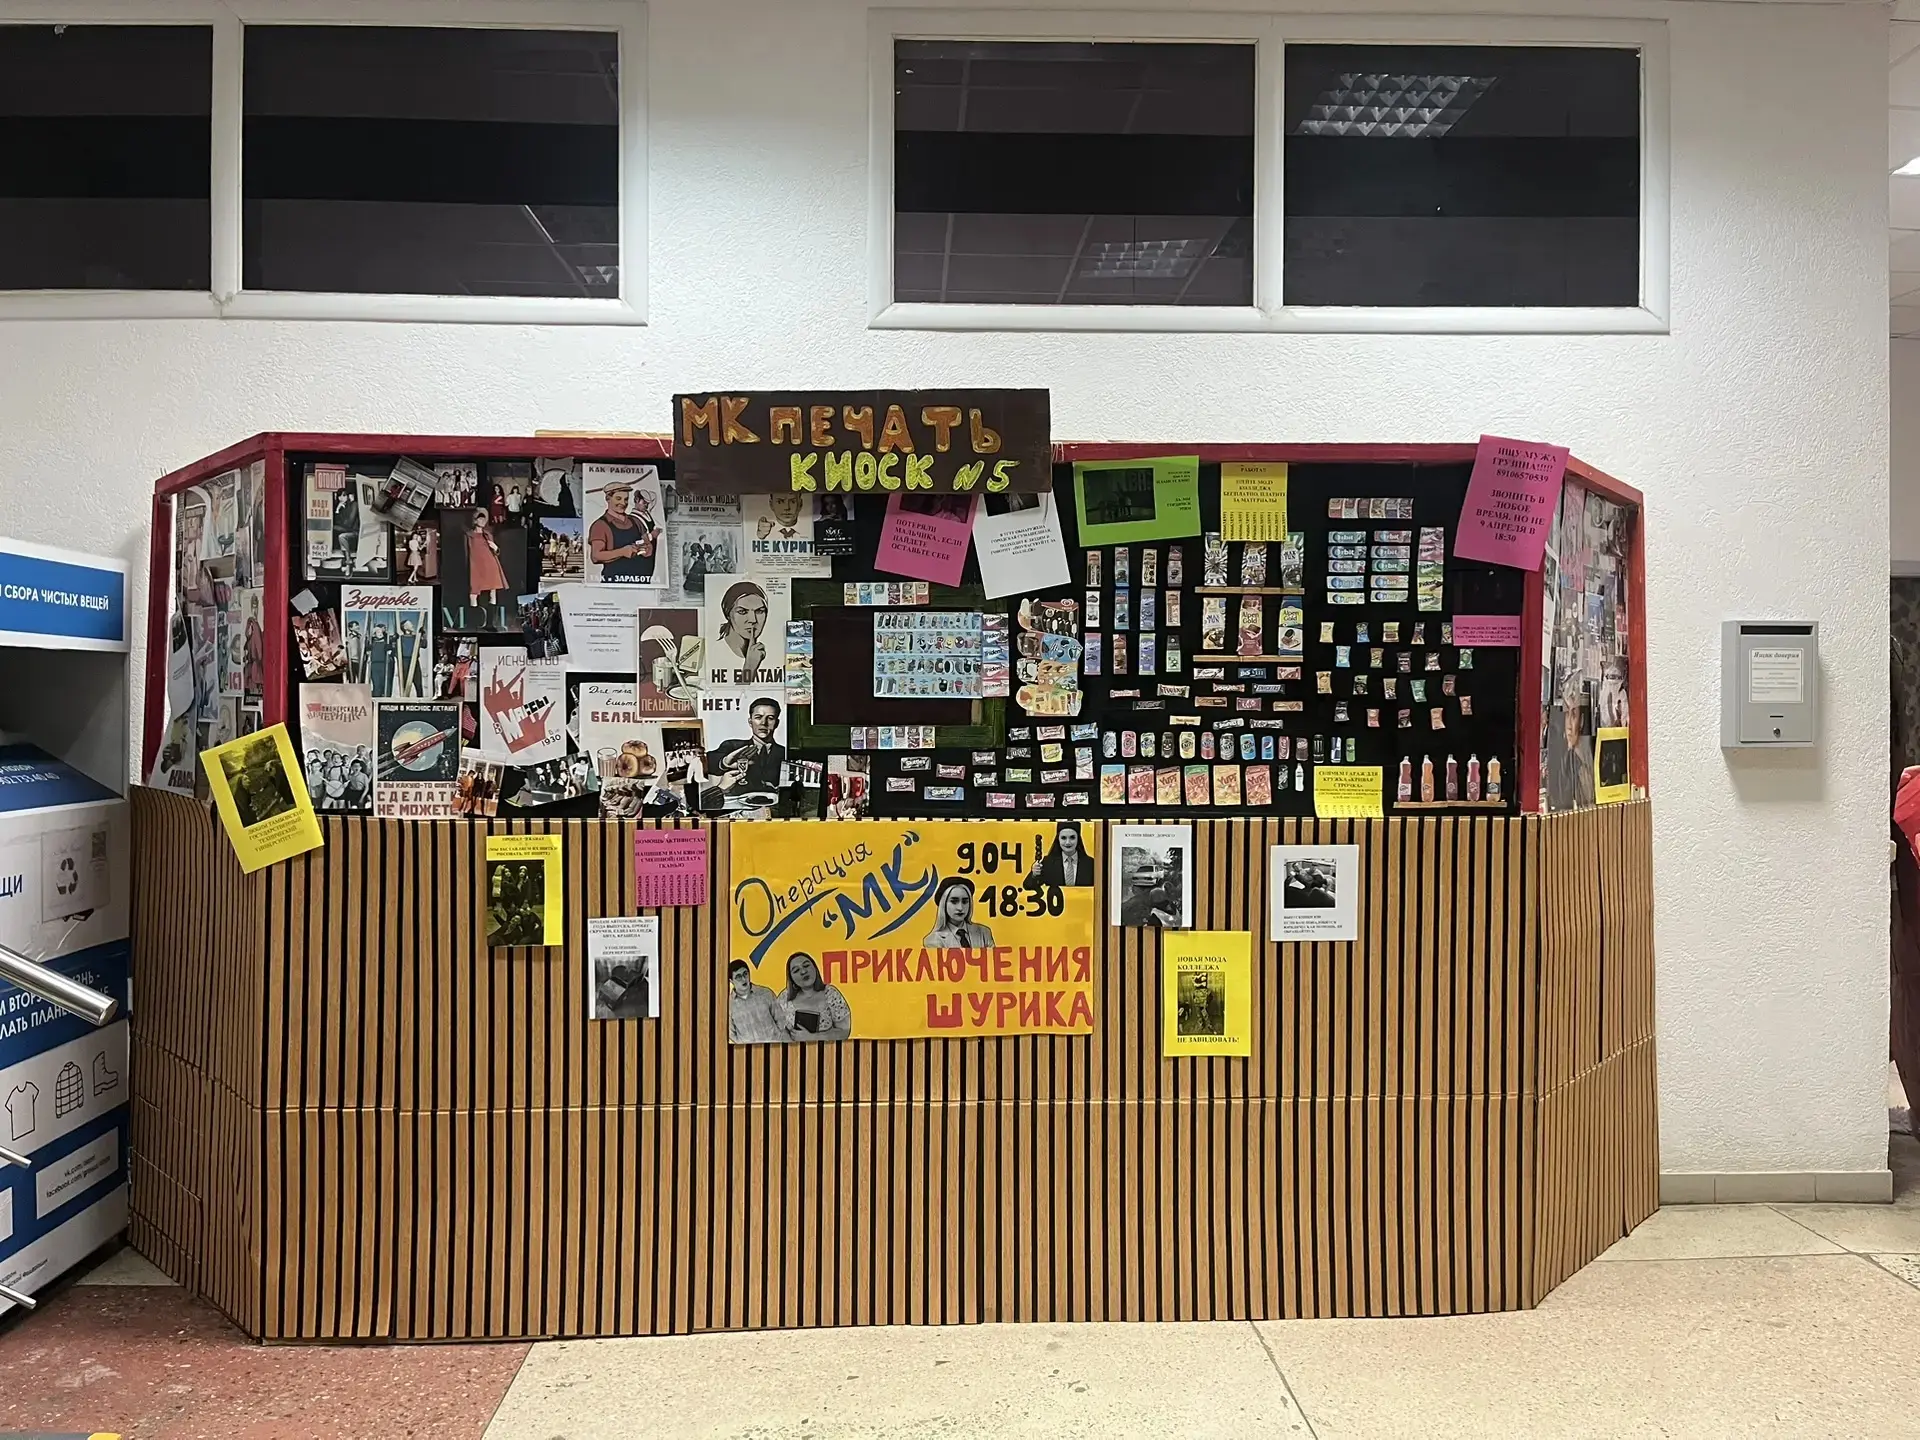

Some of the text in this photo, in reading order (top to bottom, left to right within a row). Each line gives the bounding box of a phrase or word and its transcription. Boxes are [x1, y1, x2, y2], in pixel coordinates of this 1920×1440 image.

[681, 396, 1002, 453] МК ПЕЧАТЬ
[1525, 450, 1557, 463] МУЖА
[790, 451, 935, 492] КИОСК
[1490, 489, 1545, 504] ЗВОНИТЬ В
[1493, 501, 1531, 513] ЛЮБОЕ
[896, 518, 937, 533] ПОТЕРЯЛИ
[1514, 514, 1528, 523] НО
[1531, 516, 1545, 525] НЕ
[1487, 521, 1526, 534] АПРЕЛЯ
[1529, 527, 1536, 535] В
[752, 540, 769, 552] НЕ
[893, 534, 928, 548] НАЙДЕТЕ
[942, 537, 962, 547] ЕСЛИ
[891, 543, 951, 561] ОСТАВЬТЕ СЕБЕ
[4, 584, 109, 611] СБОРА ЧИСТЫХ ВЕЩЕЙ
[345, 589, 418, 610] Здоровье
[711, 669, 728, 683] НЕ
[380, 704, 399, 712] ЛЮДИ
[405, 704, 431, 712] КОСМОС
[432, 704, 458, 712] ЛЕТАЮТ
[641, 698, 691, 712] ПЕЛЬМЕНИ
[702, 698, 741, 711] НЕТ!
[307, 705, 368, 723] ВЕЧЕРИНКА
[591, 711, 657, 723] БЕЛЯ
[541, 734, 562, 747] 1930
[377, 804, 394, 815] НЕ
[957, 842, 1022, 874] 9.04
[735, 842, 872, 936] Операция
[979, 885, 1065, 918] 18:30
[822, 946, 1091, 984] ПРИКЛЮЧЕНИЯ
[927, 991, 1093, 1028] ШУРИКА
